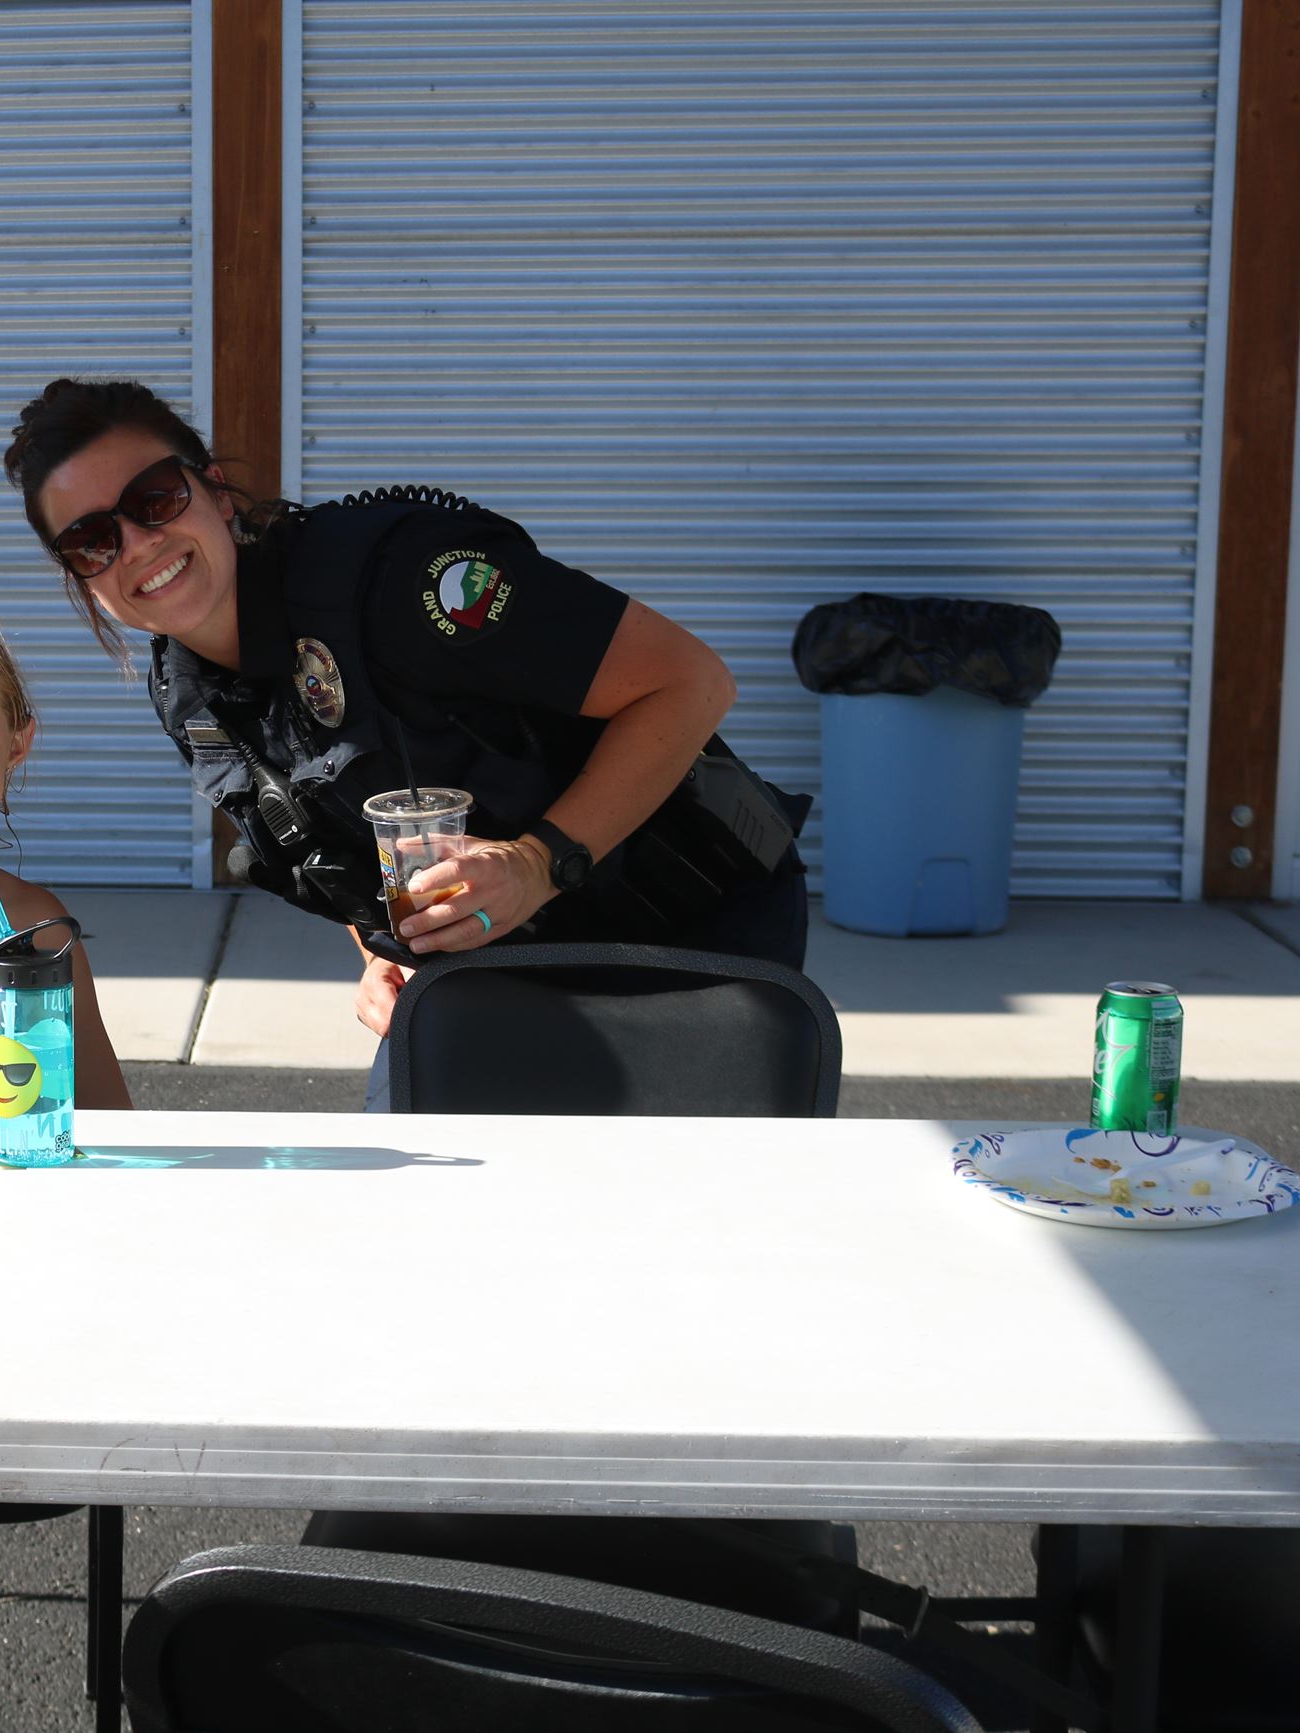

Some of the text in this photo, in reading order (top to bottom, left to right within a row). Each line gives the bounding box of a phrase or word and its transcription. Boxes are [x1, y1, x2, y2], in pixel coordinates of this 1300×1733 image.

[423, 550, 486, 635] GRAND JUNCTION
[487, 582, 512, 621] POLICE
